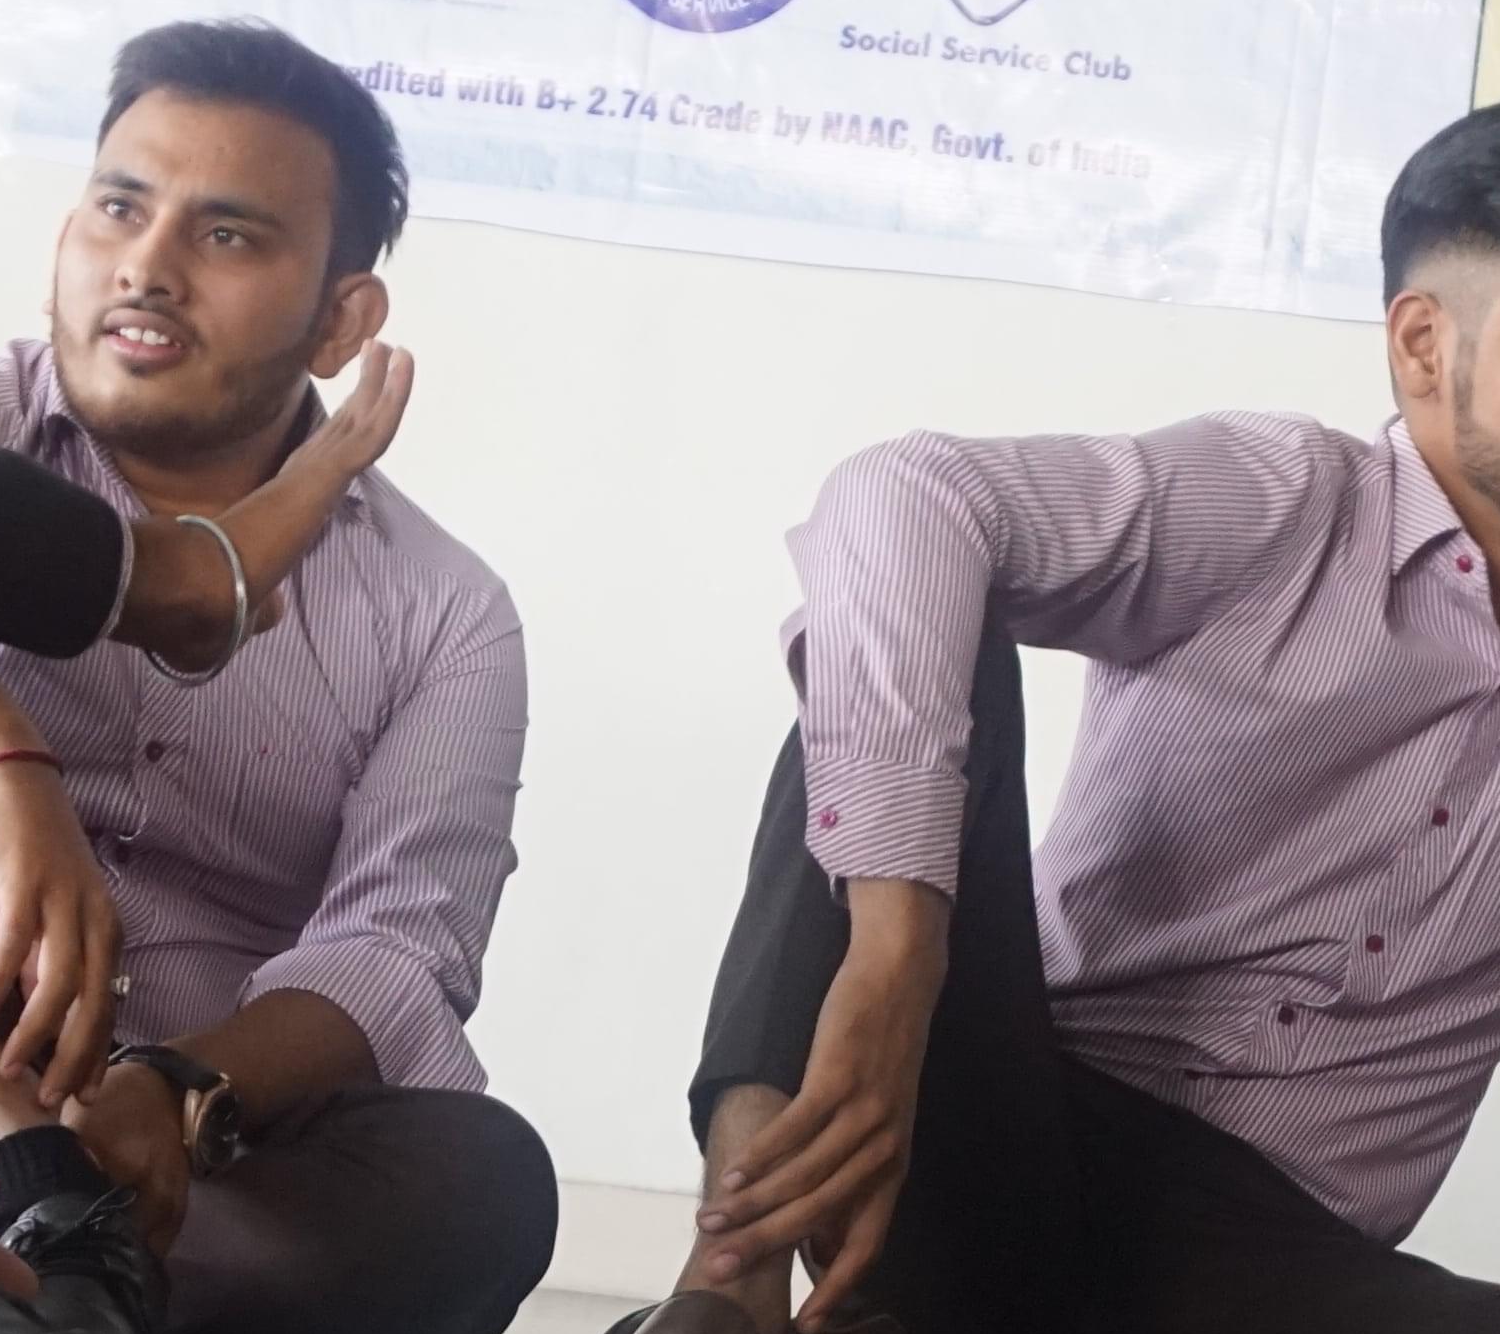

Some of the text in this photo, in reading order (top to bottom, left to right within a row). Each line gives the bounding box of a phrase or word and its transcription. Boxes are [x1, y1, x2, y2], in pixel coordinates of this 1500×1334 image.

[839, 25, 1132, 81] Social Service Club
[345, 60, 446, 97] edited
[457, 73, 525, 107] with
[536, 80, 577, 111] B+
[586, 86, 658, 122] 2.74
[669, 93, 761, 134] Grade
[774, 106, 811, 143] by
[932, 123, 1013, 163] Govt.
[1027, 139, 1061, 166] of
